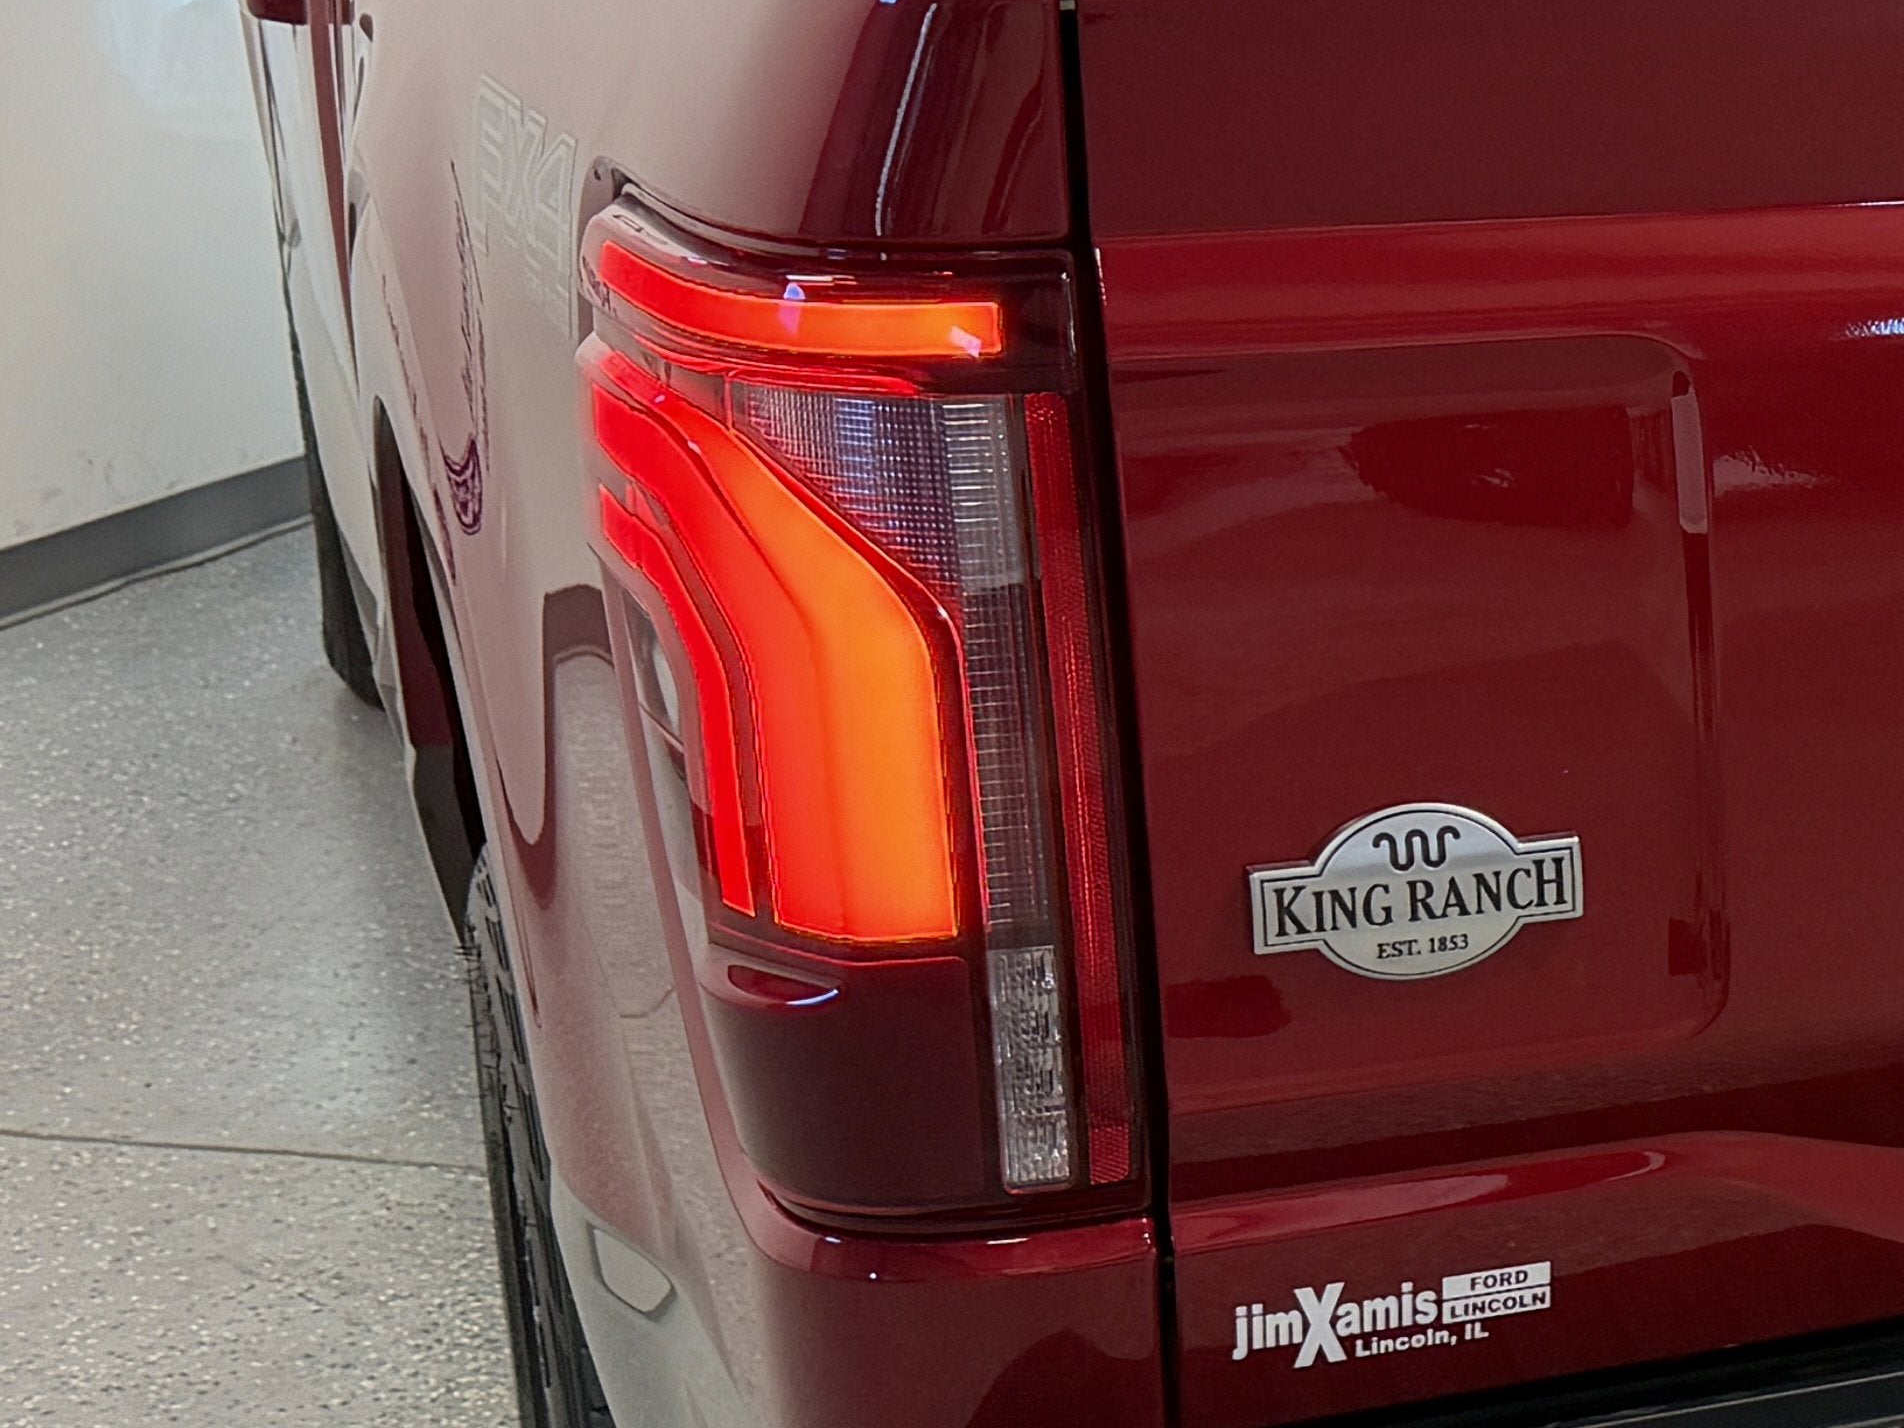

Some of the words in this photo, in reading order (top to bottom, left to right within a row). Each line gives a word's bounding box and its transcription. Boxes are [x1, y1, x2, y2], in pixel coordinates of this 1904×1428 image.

[1273, 884, 1394, 938] KING
[1406, 856, 1569, 922] RANCH
[1376, 938, 1422, 959] EST.
[1428, 933, 1469, 953] 1853
[1470, 1269, 1529, 1291] FORD
[1450, 1292, 1547, 1320] LINCOLN
[1355, 1328, 1457, 1358] Lincoln,
[1464, 1321, 1490, 1341] IL
